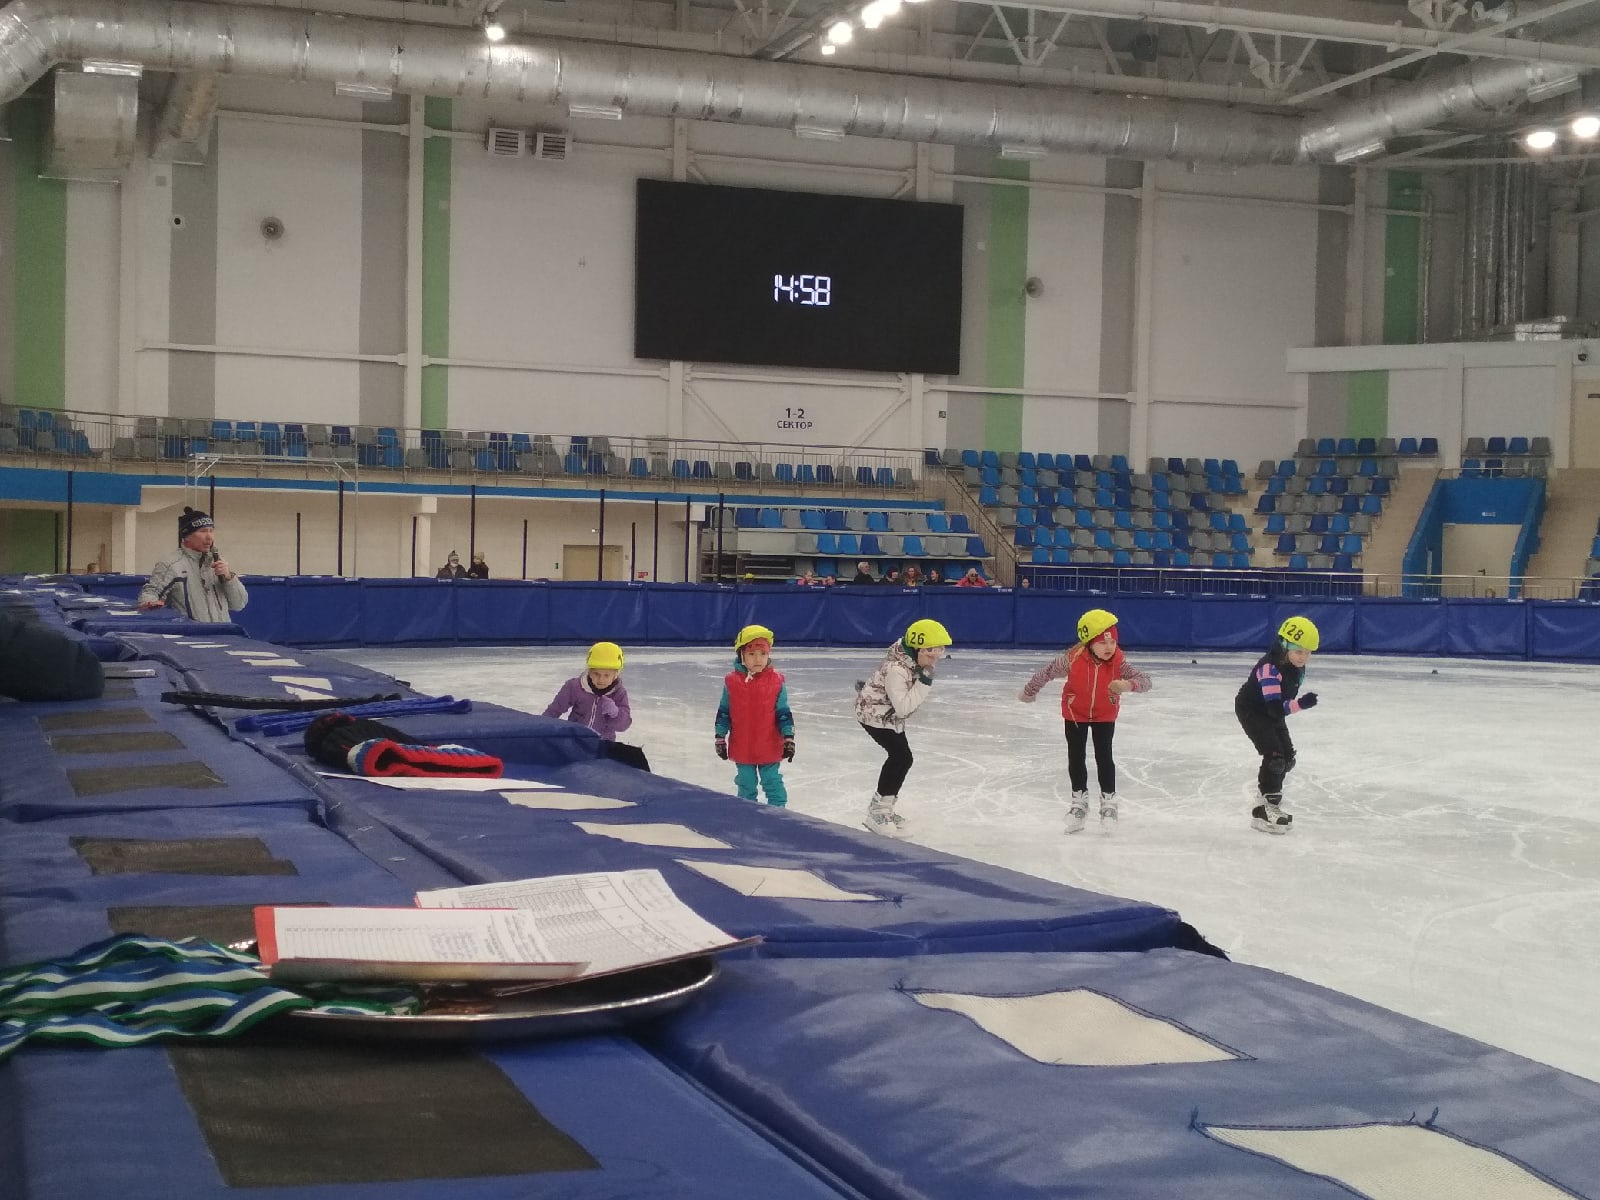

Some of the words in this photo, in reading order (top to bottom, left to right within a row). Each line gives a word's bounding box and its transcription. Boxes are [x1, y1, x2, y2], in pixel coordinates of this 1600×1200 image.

[774, 275, 831, 305] 14:58
[785, 407, 805, 419] 1-2
[776, 420, 813, 430] СЕКТОР
